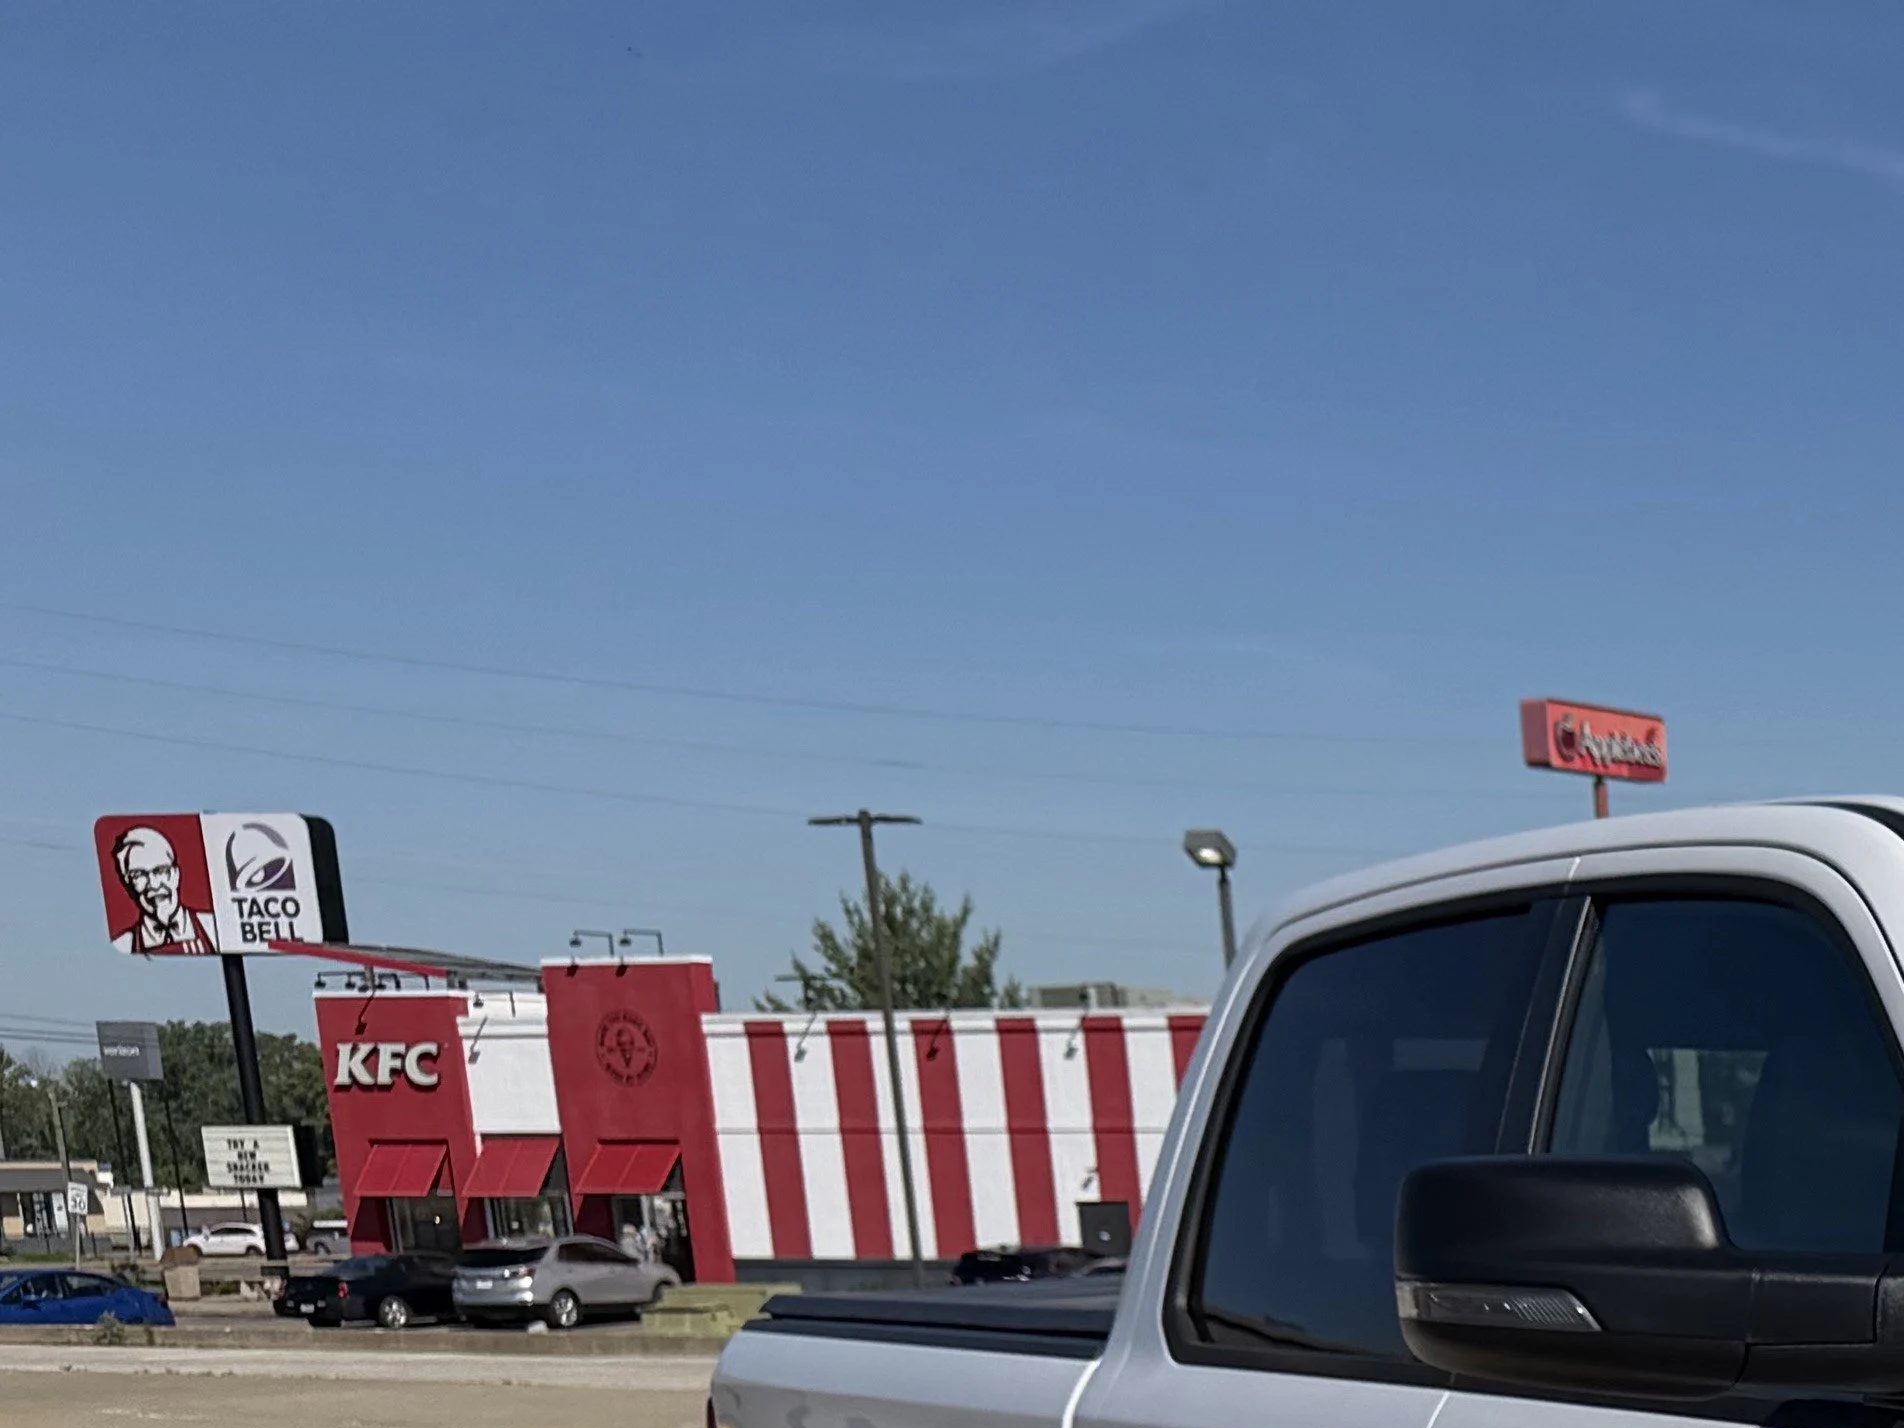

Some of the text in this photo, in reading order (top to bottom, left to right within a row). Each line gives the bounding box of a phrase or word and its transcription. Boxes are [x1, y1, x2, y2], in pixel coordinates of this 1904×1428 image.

[231, 896, 300, 919] TACO
[241, 921, 304, 943] BELL
[333, 1041, 441, 1091] KFC
